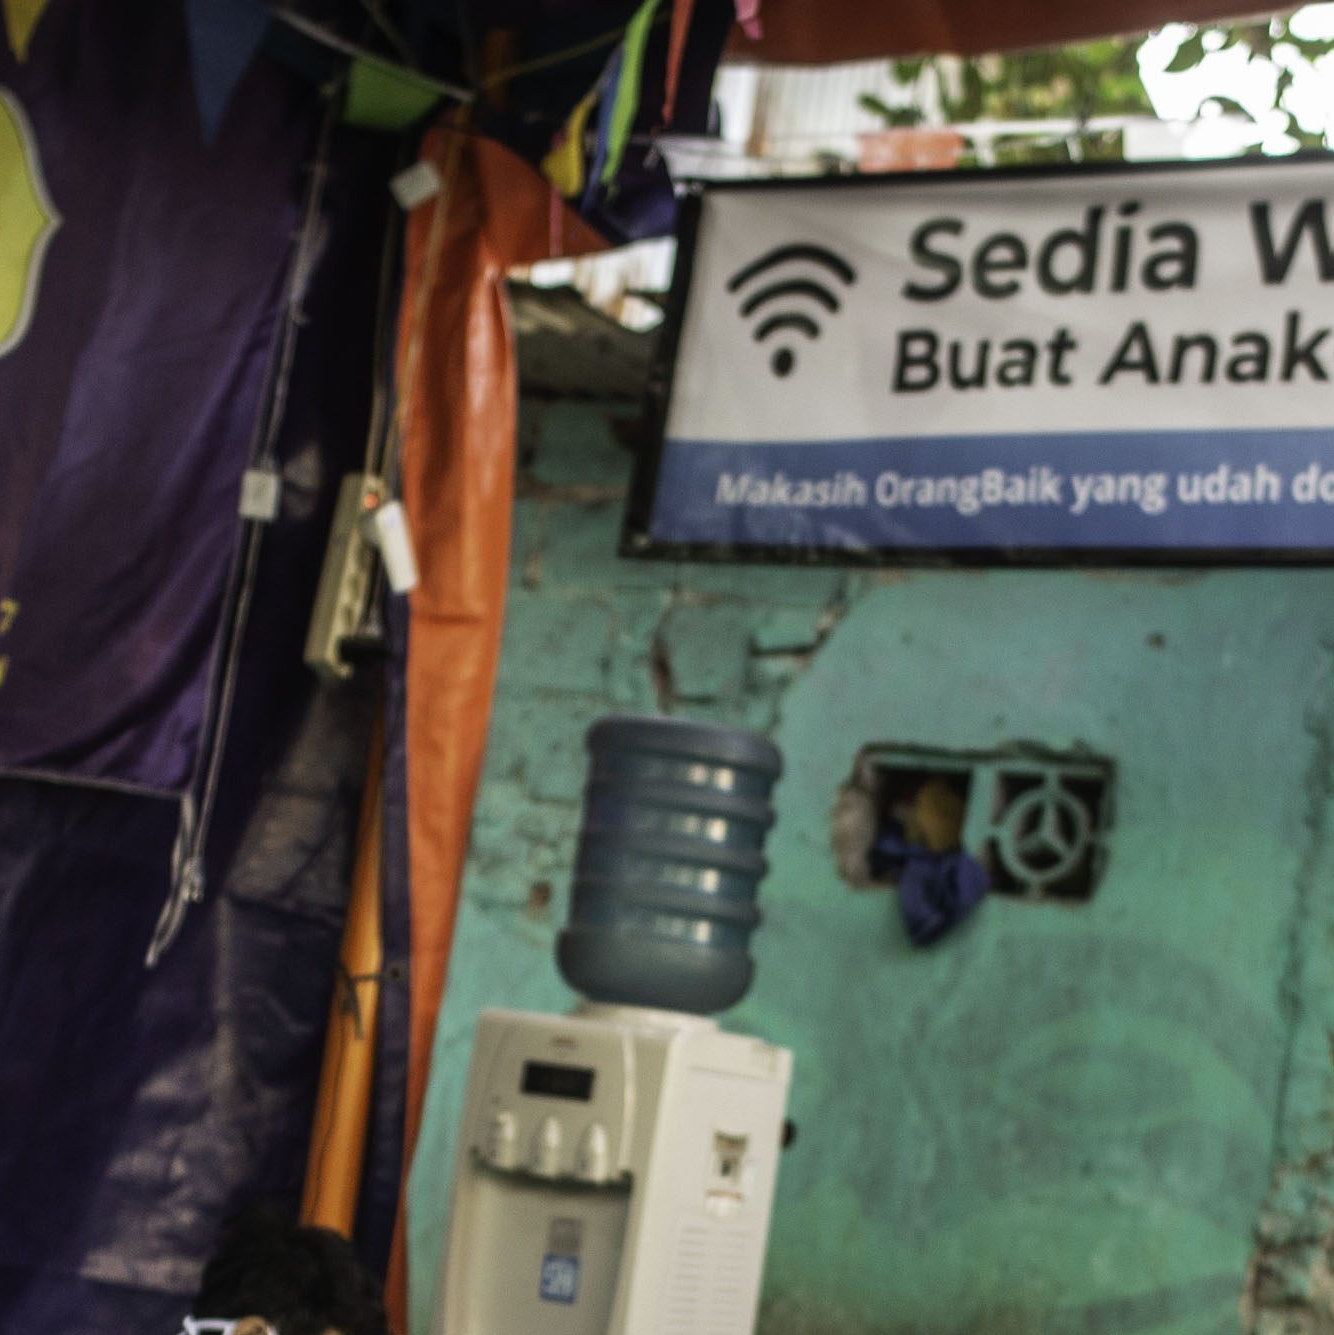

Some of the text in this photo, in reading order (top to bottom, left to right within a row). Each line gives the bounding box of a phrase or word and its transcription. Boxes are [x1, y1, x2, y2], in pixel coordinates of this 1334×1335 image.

[901, 204, 1199, 302] Sedia
[891, 325, 1079, 393] Buat
[716, 470, 866, 509] Makasih
[875, 470, 1062, 516] OrangBaik
[1072, 474, 1166, 516] yang
[1176, 469, 1279, 506] udah
